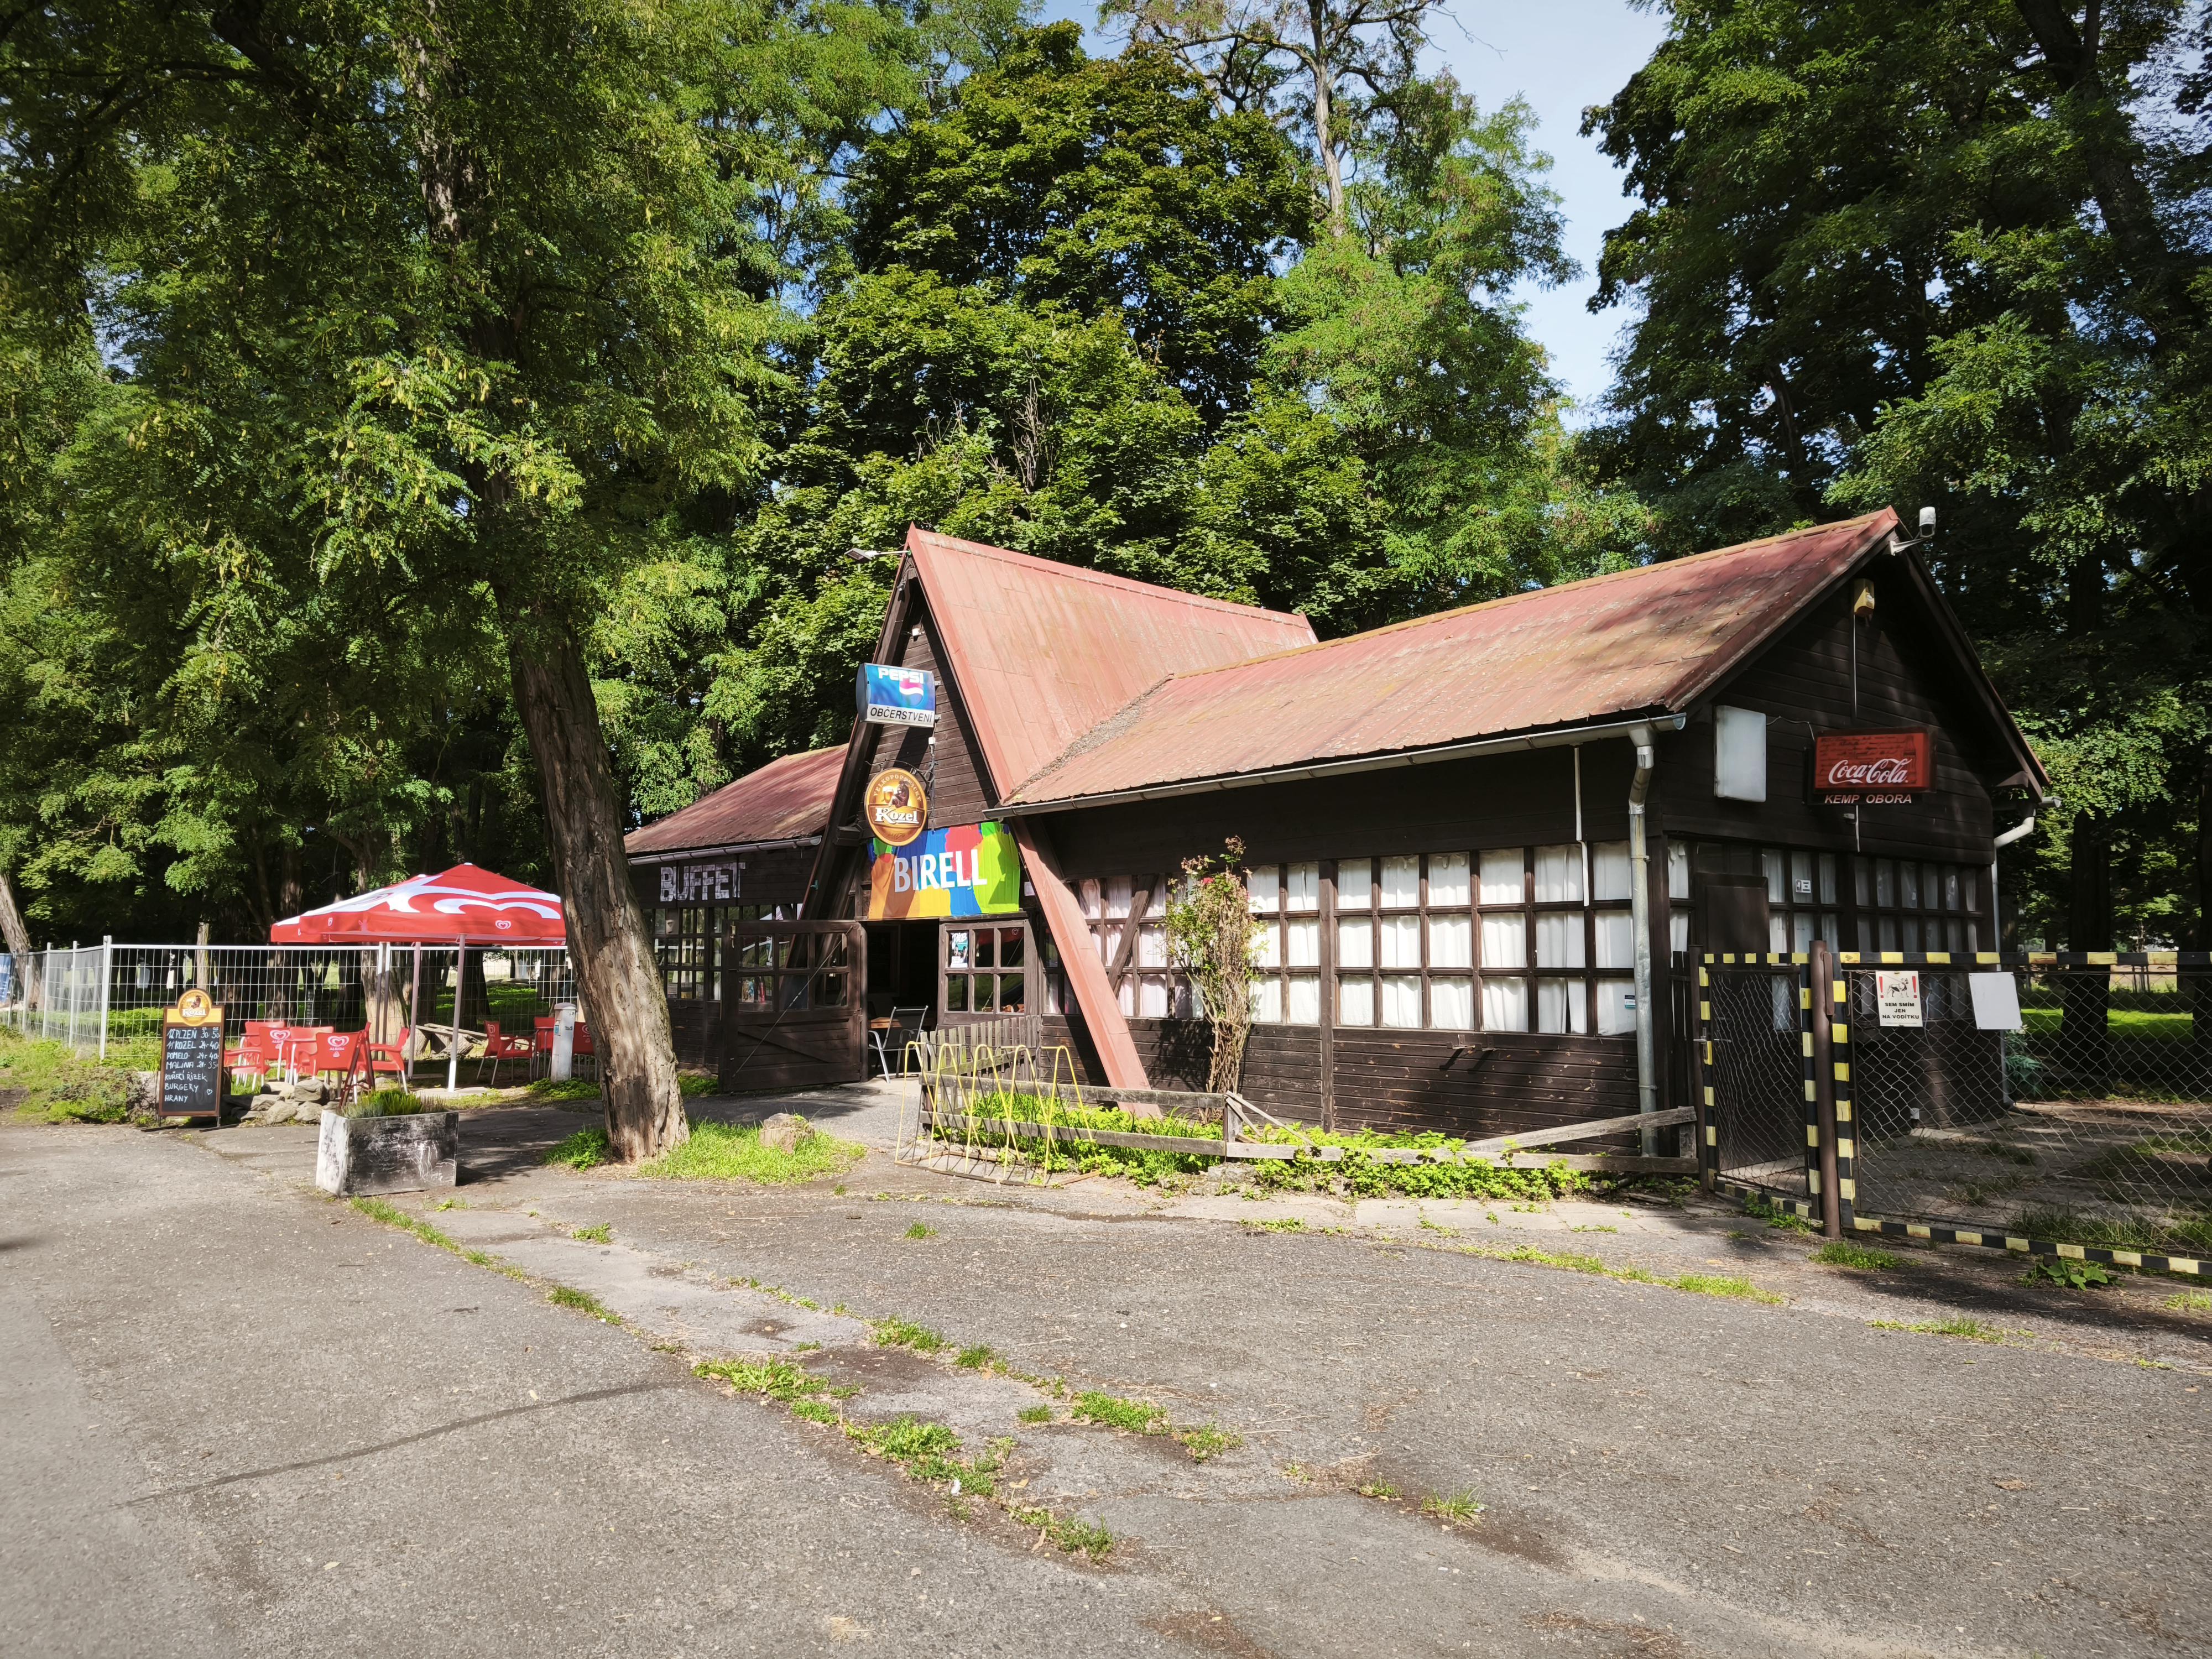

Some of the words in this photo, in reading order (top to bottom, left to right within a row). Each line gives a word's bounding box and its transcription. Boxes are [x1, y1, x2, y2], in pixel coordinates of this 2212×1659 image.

[878, 667, 924, 684] PEPSI
[870, 707, 932, 723] OBČERSTVENÍ
[1828, 758, 1912, 784] Coca-Cola
[1825, 795, 1860, 804] KEMP
[1866, 794, 1912, 804] OBORA
[875, 807, 919, 825] Kozel
[894, 849, 987, 893] BIRELL
[660, 862, 745, 902] BUFFET
[175, 1041, 196, 1050] KOZEL
[165, 1070, 185, 1081] KUŘECÍ
[164, 1083, 199, 1093] BURGERY
[164, 1094, 189, 1103] HRANY
